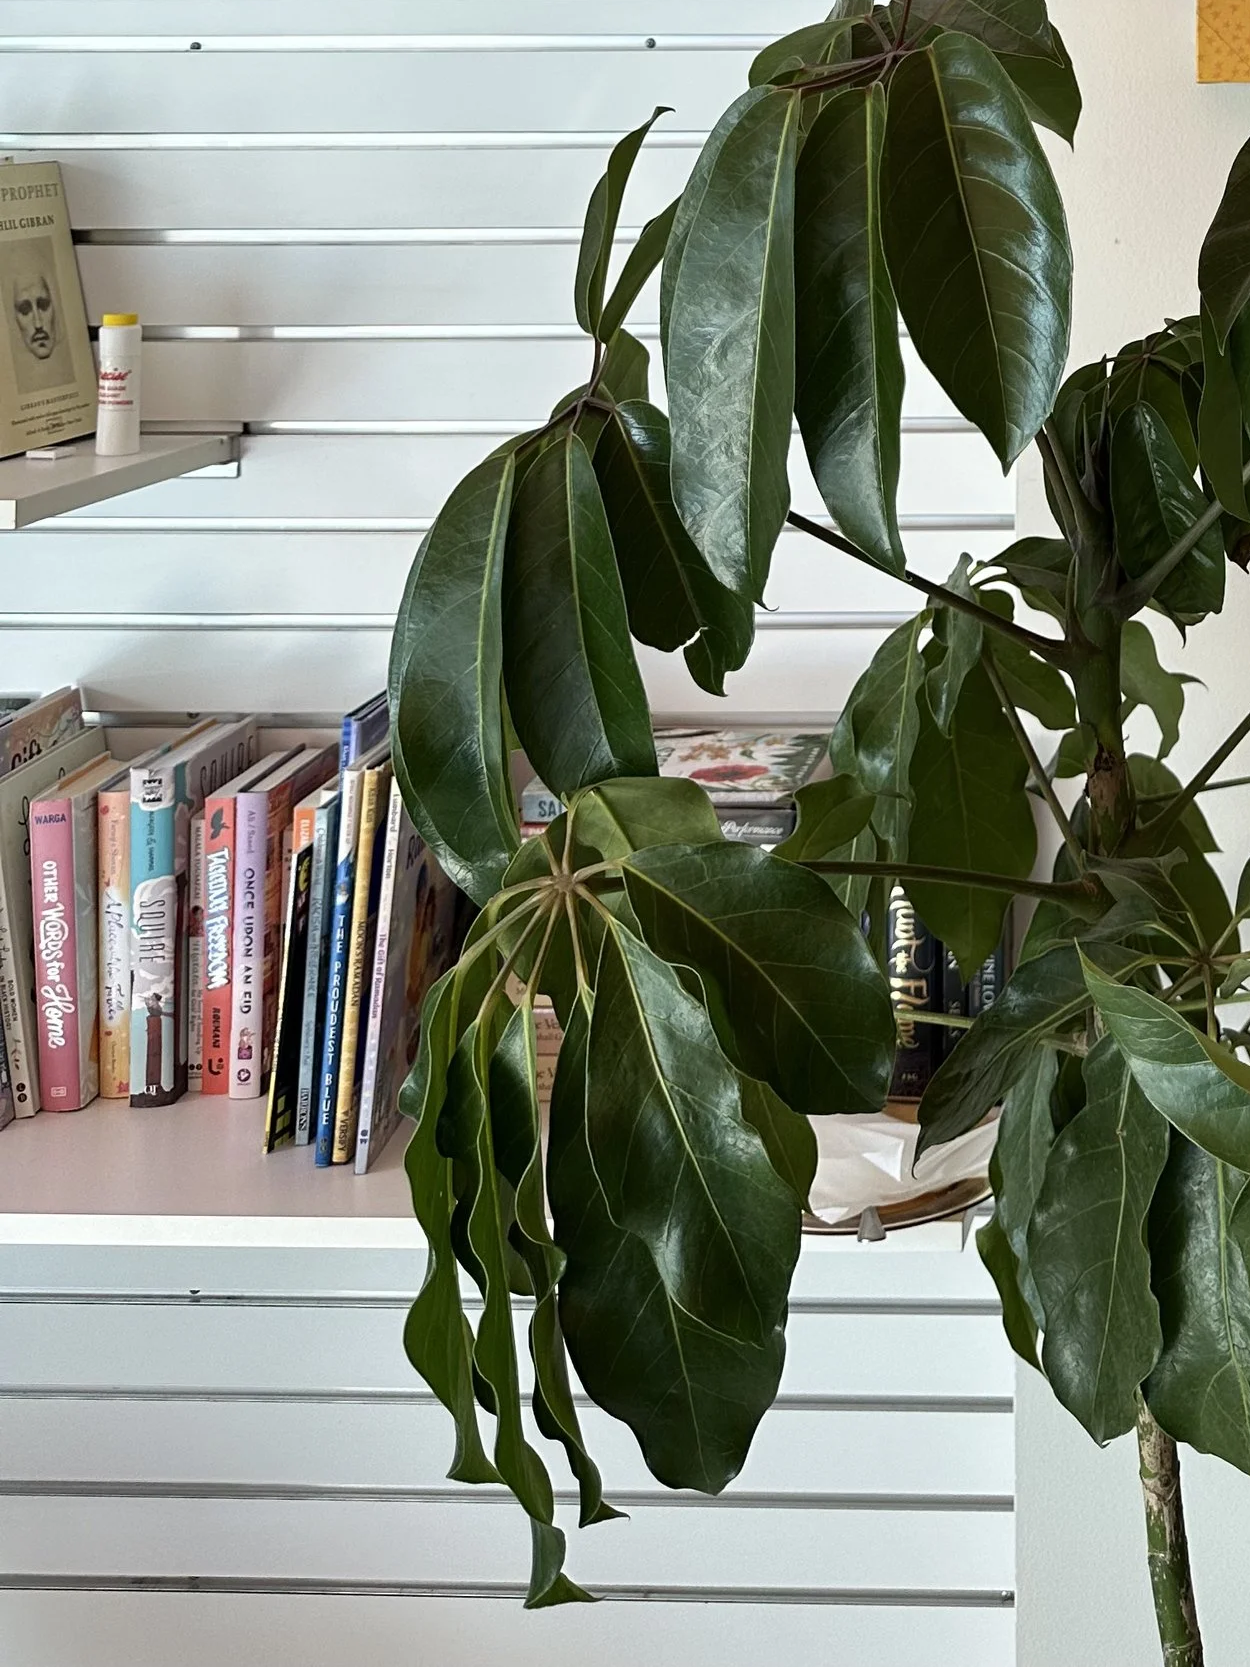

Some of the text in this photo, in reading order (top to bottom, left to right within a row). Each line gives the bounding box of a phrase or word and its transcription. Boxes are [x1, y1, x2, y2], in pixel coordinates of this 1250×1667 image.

[1, 183, 60, 202] PROPHET
[19, 214, 55, 230] GIBRAN
[34, 814, 67, 825] WARGA
[40, 860, 75, 1048] OTHER WORDS for Home
[138, 899, 166, 964] SQUIRE
[239, 868, 256, 1015] ONCE UPON AN EID
[321, 914, 346, 1126] THE PROUDEST BLUE
